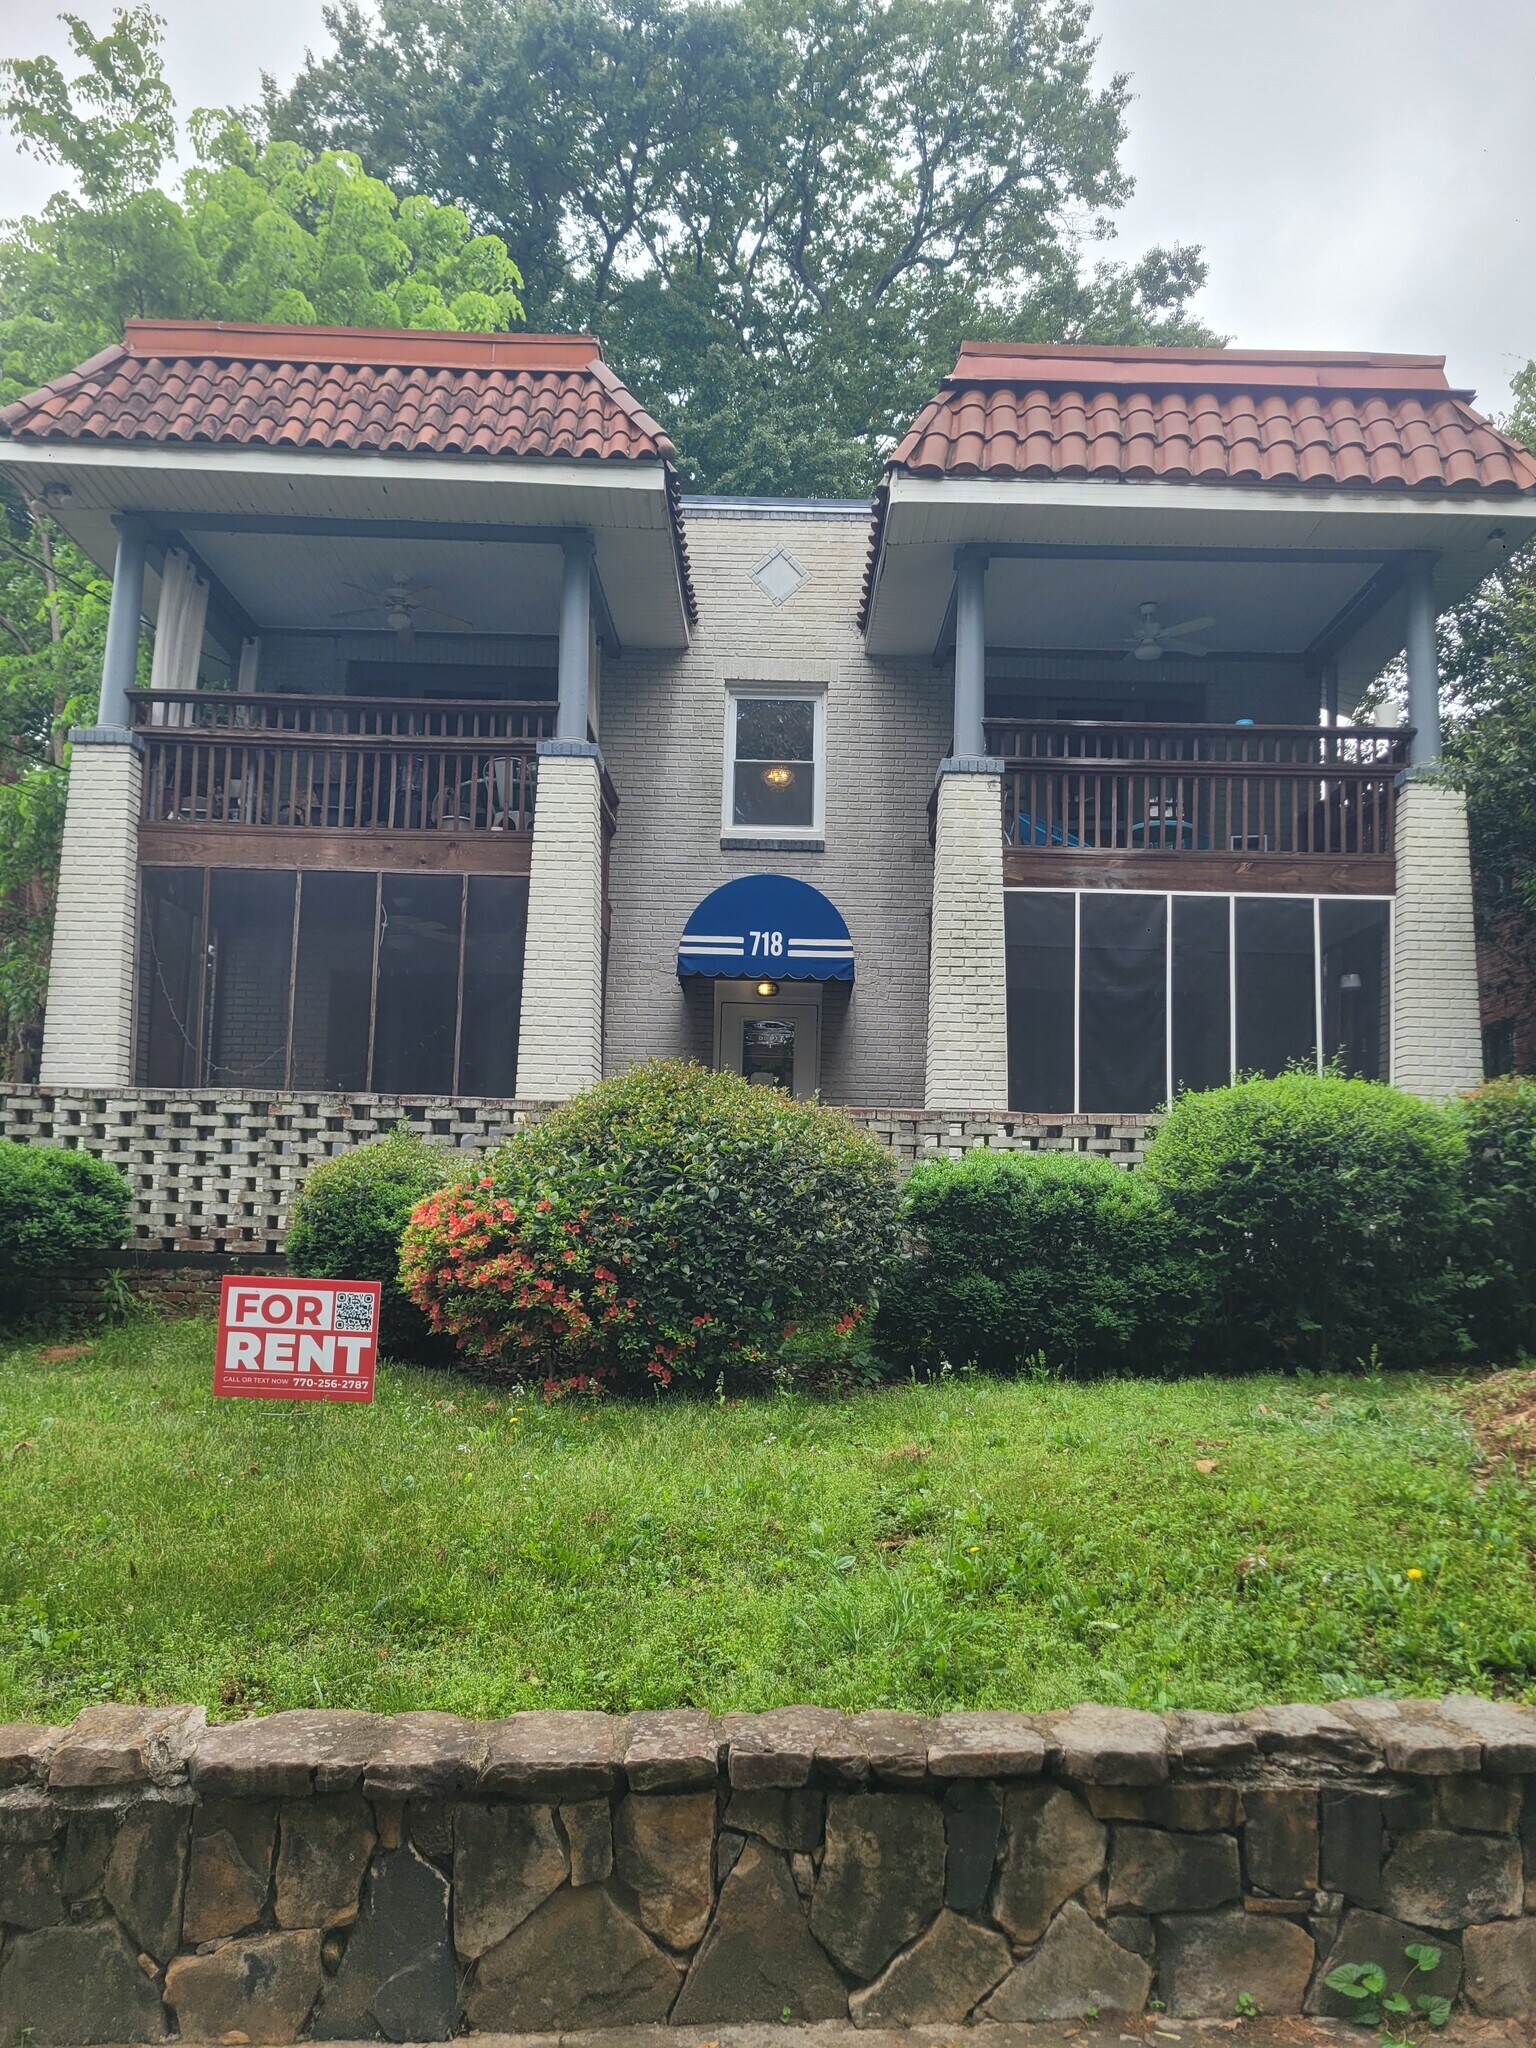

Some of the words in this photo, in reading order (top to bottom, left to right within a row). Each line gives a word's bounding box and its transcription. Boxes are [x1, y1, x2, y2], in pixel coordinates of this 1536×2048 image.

[749, 931, 783, 957] 718
[235, 1293, 323, 1326] FOR
[224, 1331, 372, 1375] RENT
[292, 1377, 369, 1390] 770-256-2787
